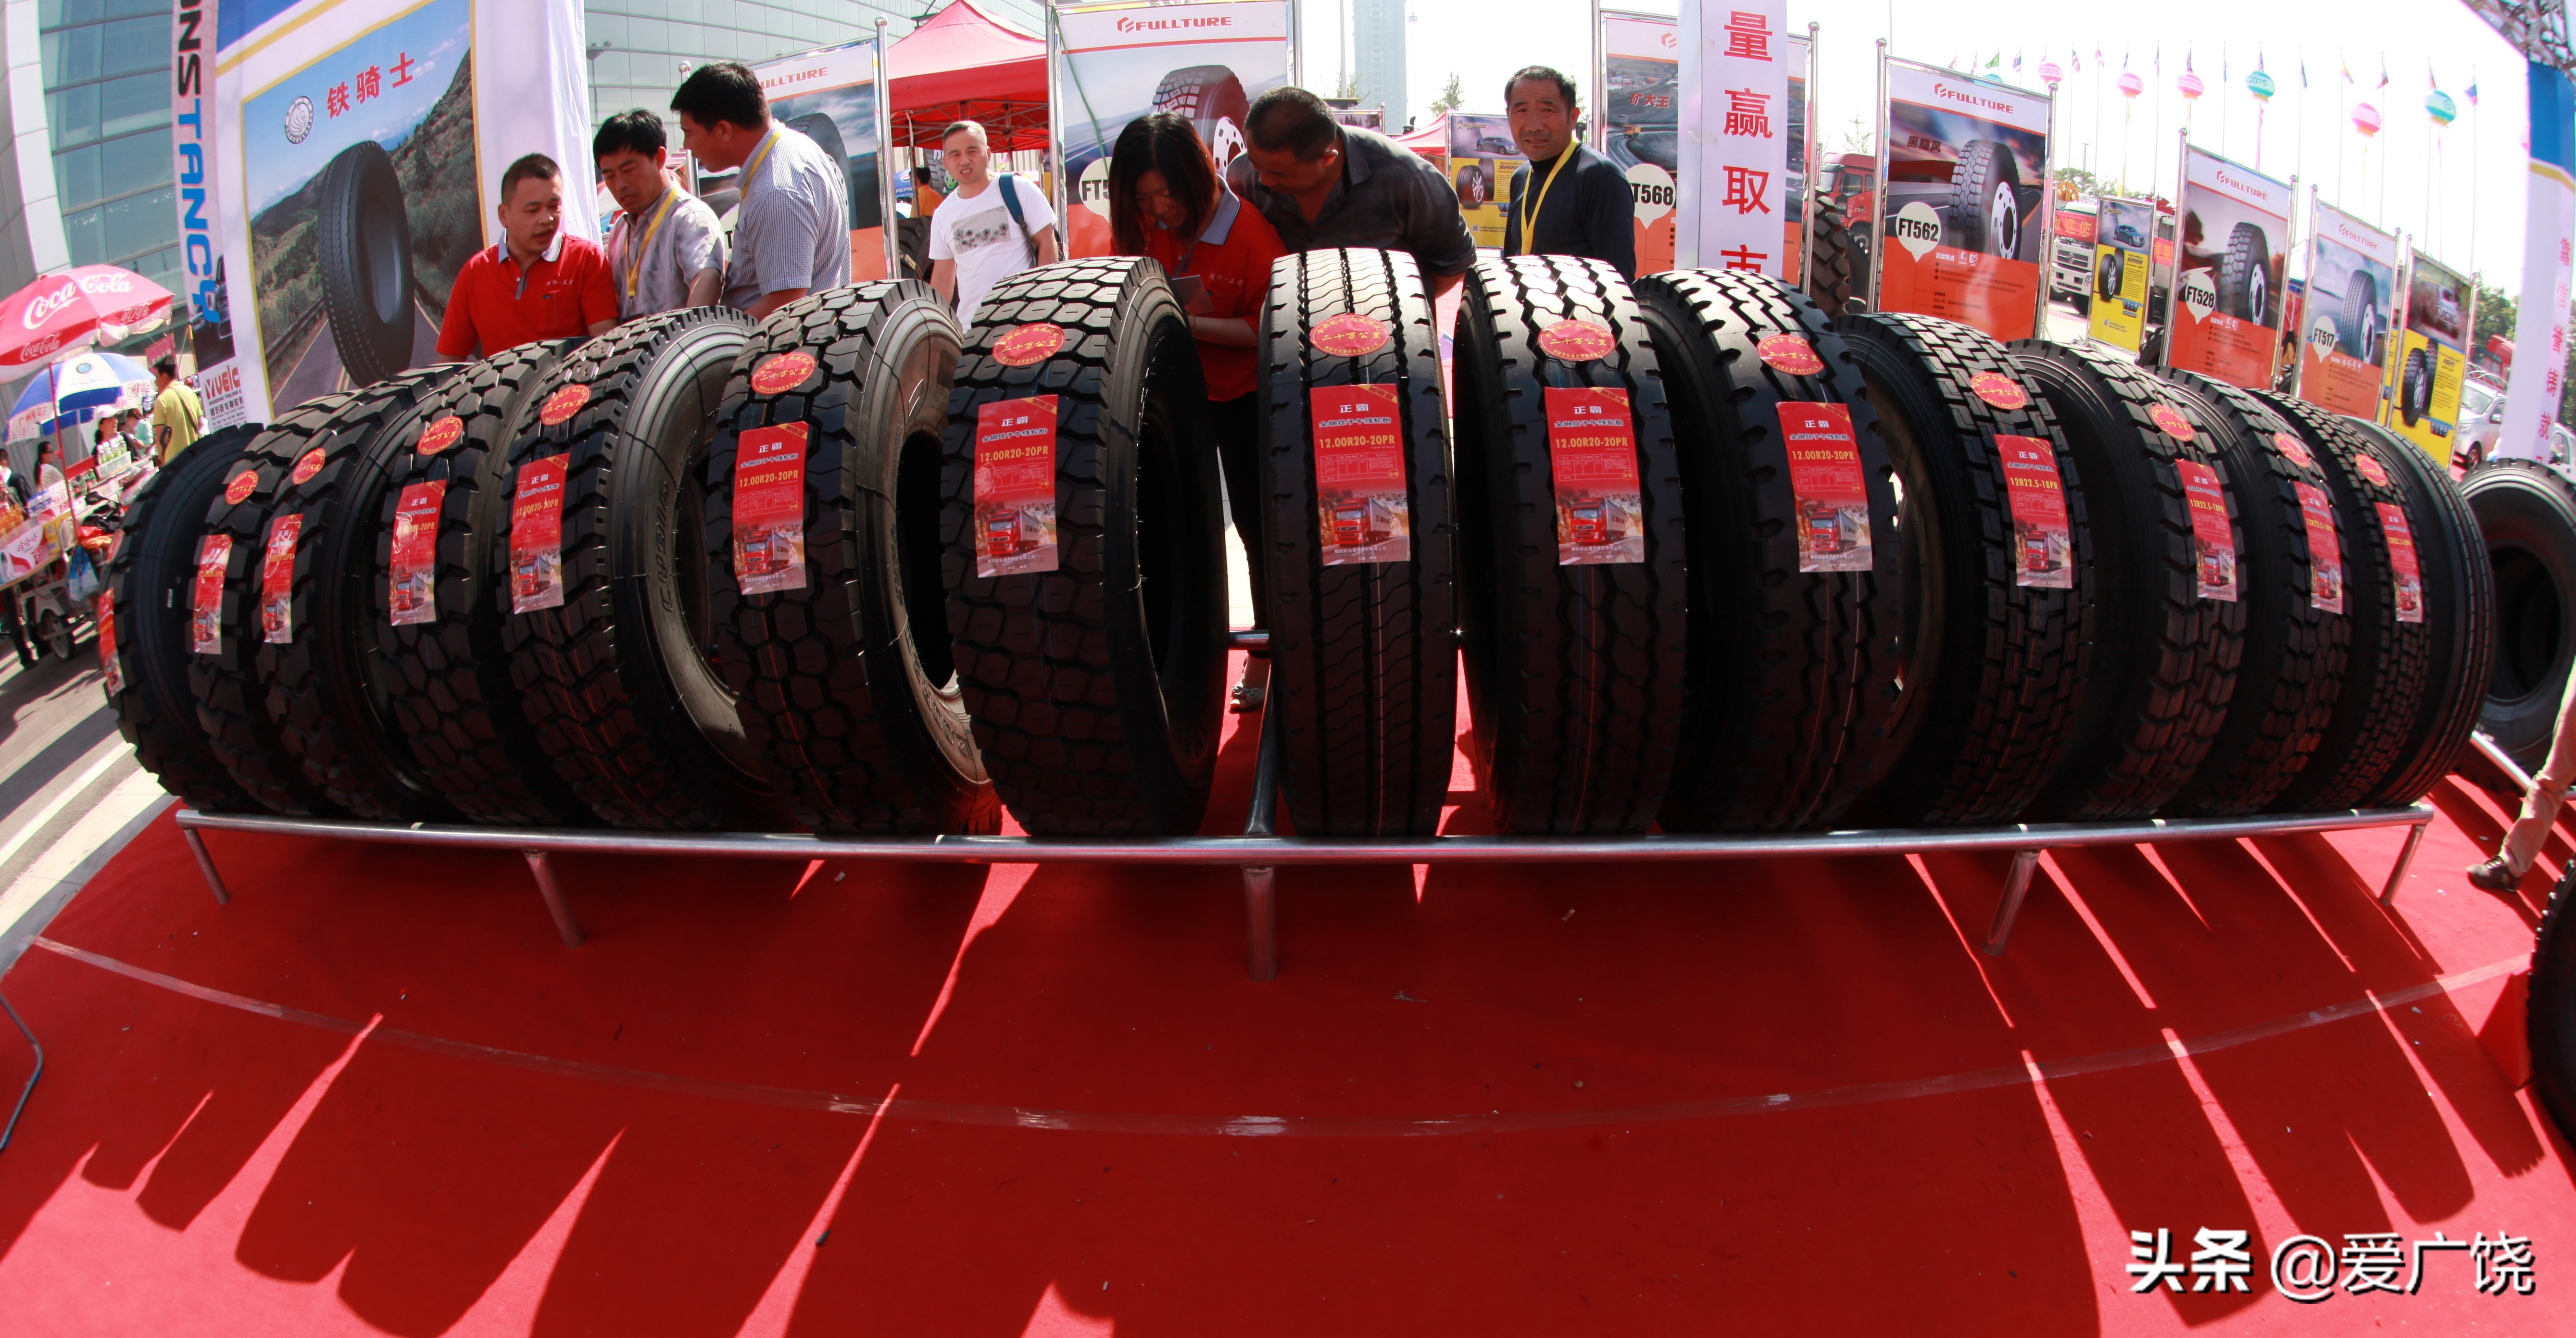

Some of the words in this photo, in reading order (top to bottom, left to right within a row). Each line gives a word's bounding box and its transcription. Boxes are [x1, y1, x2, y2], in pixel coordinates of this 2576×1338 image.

[1135, 16, 1232, 31] FULLTURE
[760, 67, 829, 90] ULLTURE
[2044, 67, 2060, 76] 2015
[327, 51, 415, 119] 铁骑士
[1629, 92, 1670, 108] 矿大王
[1948, 90, 2014, 114] FULLTURE
[1907, 136, 1942, 153] 黑旋风
[1631, 182, 1674, 206] T568
[2224, 177, 2268, 201] FULLTURE
[1898, 218, 1938, 243] FT562
[2345, 229, 2378, 251] FULLTURE
[1935, 251, 1955, 262] 花纹特点
[2185, 285, 2215, 308] FT528
[1321, 332, 1381, 341] 二十万公里
[1549, 338, 1607, 346] 二十万公里
[2312, 332, 2335, 349] FT517
[1001, 339, 1056, 352] 二十万公里
[1768, 351, 1819, 362] 二十万公里
[759, 367, 807, 381] 二十万公里
[1981, 388, 2020, 398] 二十万公里
[546, 398, 584, 413] 二十万公里
[1319, 434, 1395, 449] 12.00R20-20PR
[1555, 437, 1628, 449] 12.00R20-20PR
[980, 445, 1049, 463] 12.00R20-20PR
[1792, 450, 1855, 460] 12.00R20-20PR
[739, 470, 799, 488] 12.00R20-20PR
[2010, 477, 2059, 490] 12R22.5-18PR
[515, 499, 559, 517] 12.00R20-20PR
[2189, 499, 2225, 513] 12R22.5-18PR
